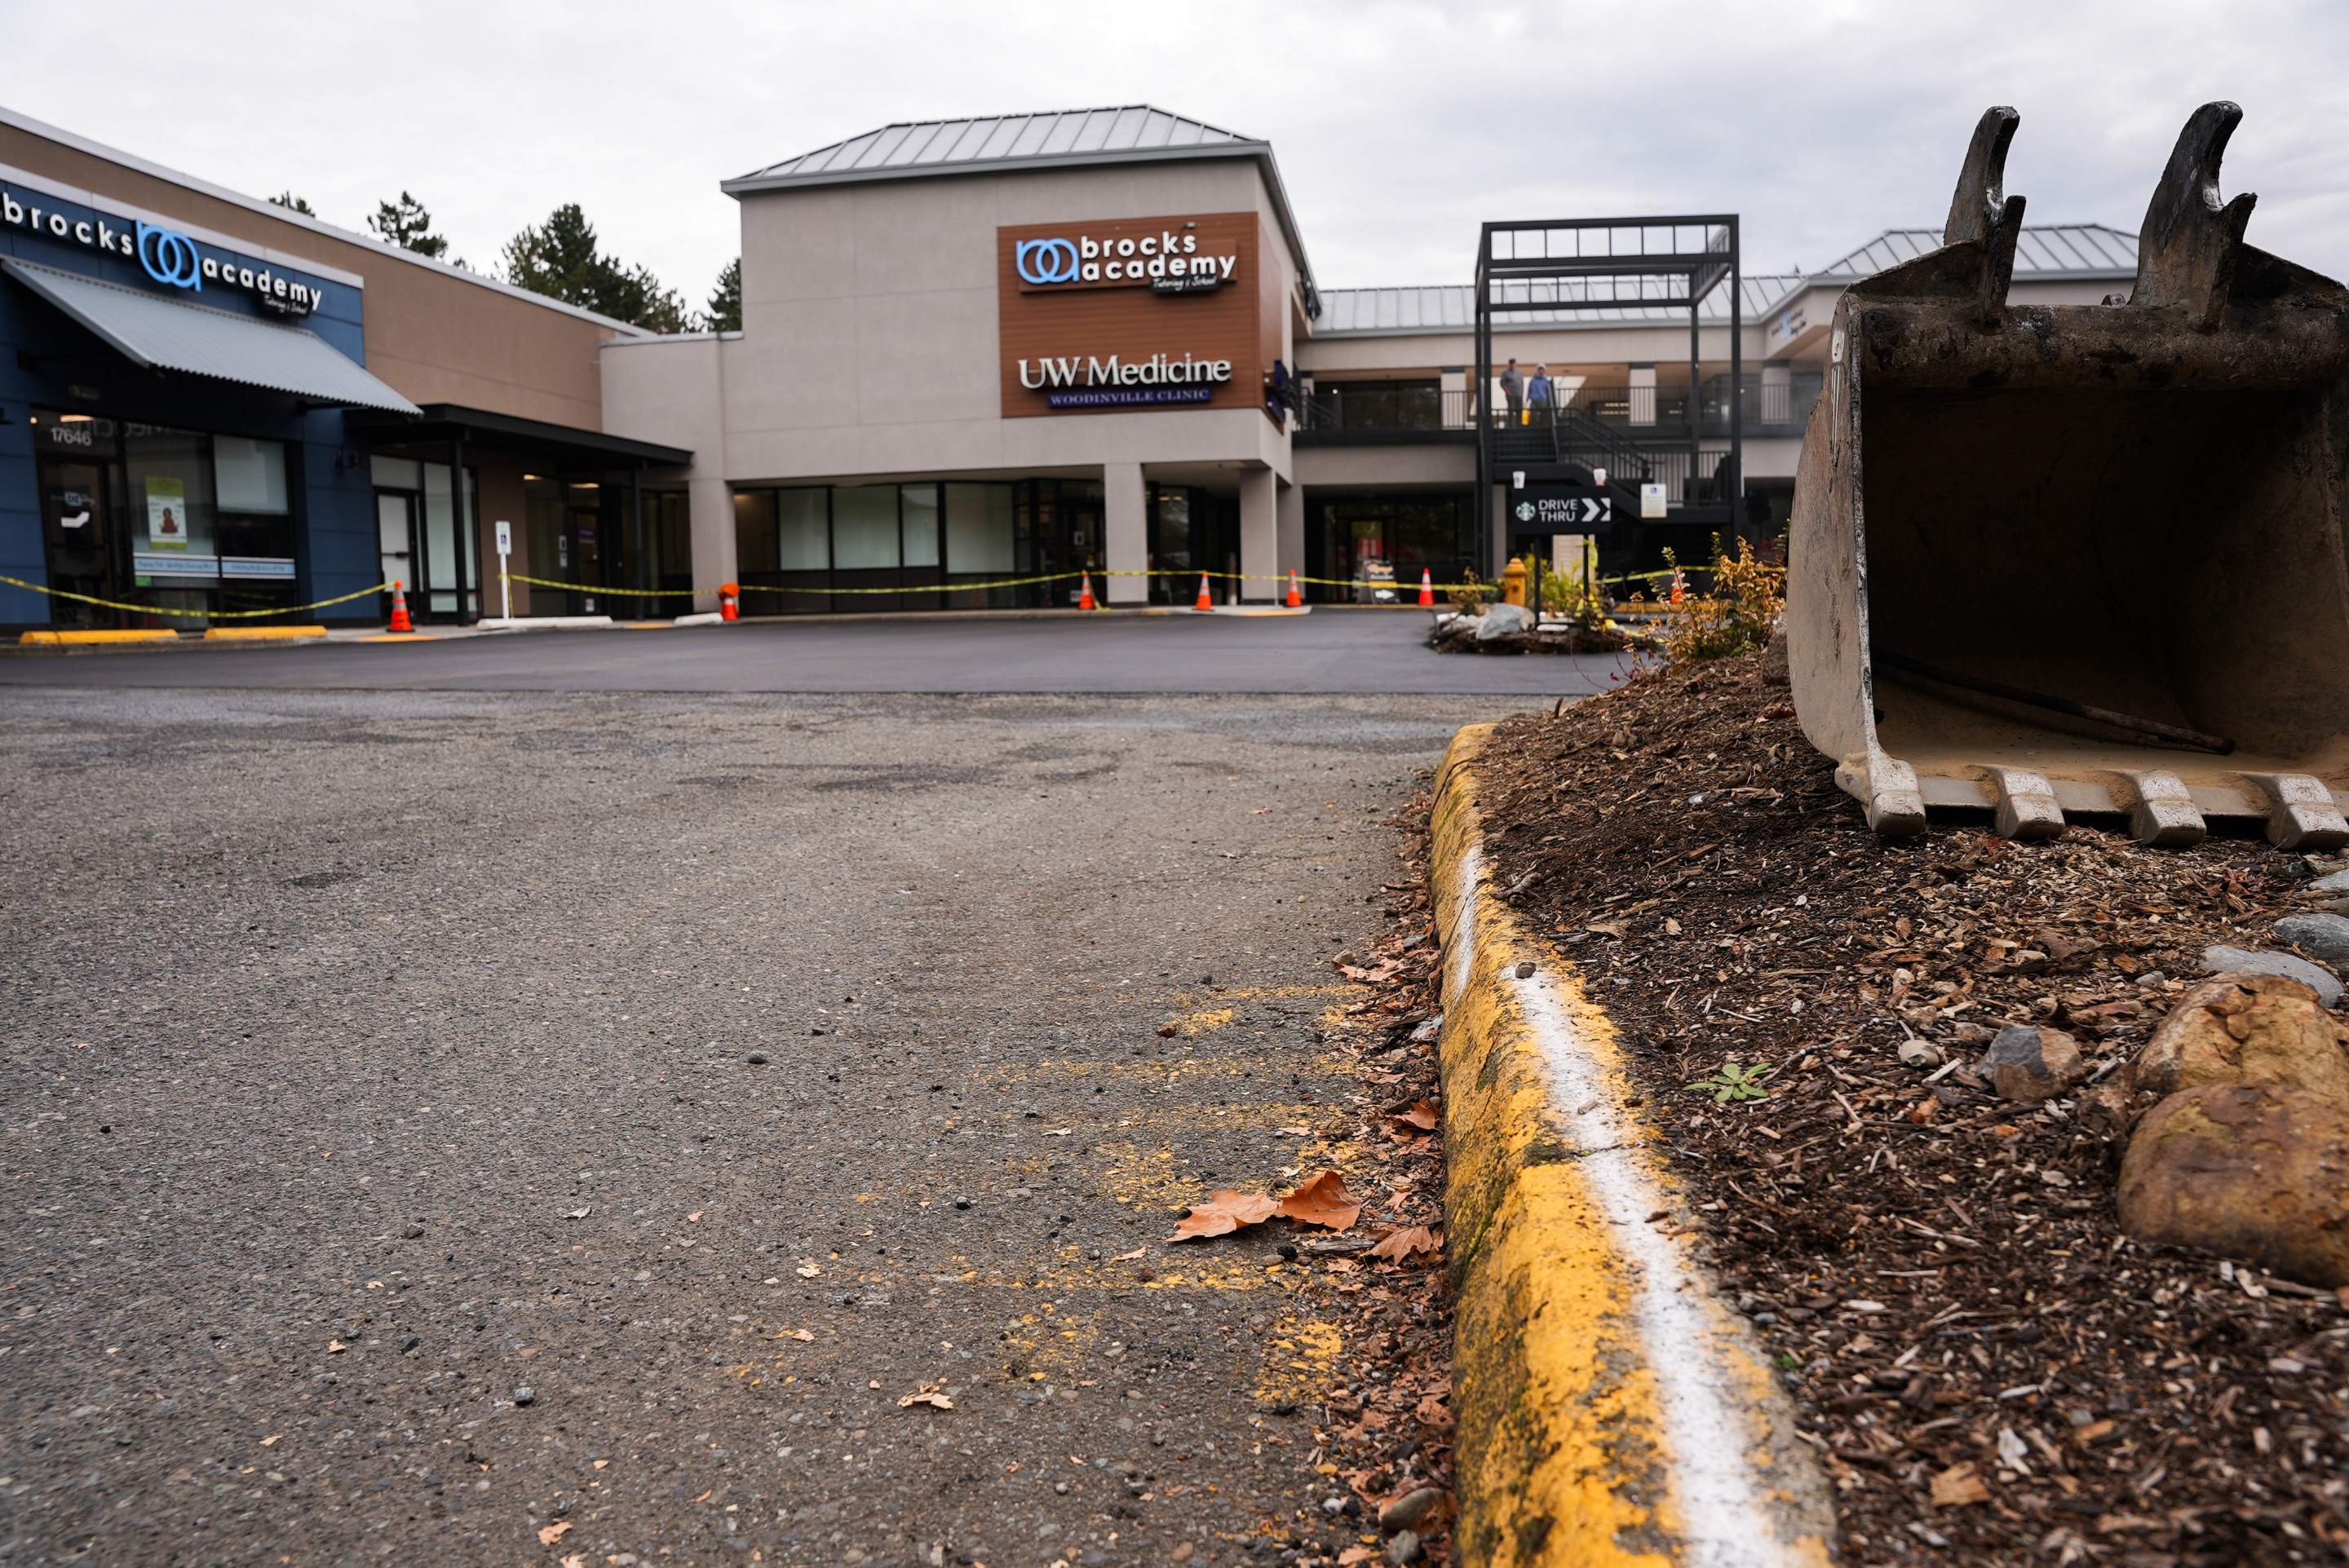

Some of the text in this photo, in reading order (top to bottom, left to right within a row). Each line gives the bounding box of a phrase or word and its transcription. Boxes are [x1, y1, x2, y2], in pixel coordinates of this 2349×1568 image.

[2, 192, 133, 256] brocks
[202, 257, 322, 311] academy
[1081, 231, 1197, 258] brocks
[1082, 254, 1236, 281] academy
[1192, 276, 1218, 288] School
[1018, 352, 1232, 389] UW Medicine
[1050, 389, 1210, 405] WOODINVILLE CLINIC
[51, 427, 92, 447] 17646
[1538, 498, 1578, 510] DRIVE
[1538, 511, 1576, 523] THRU
